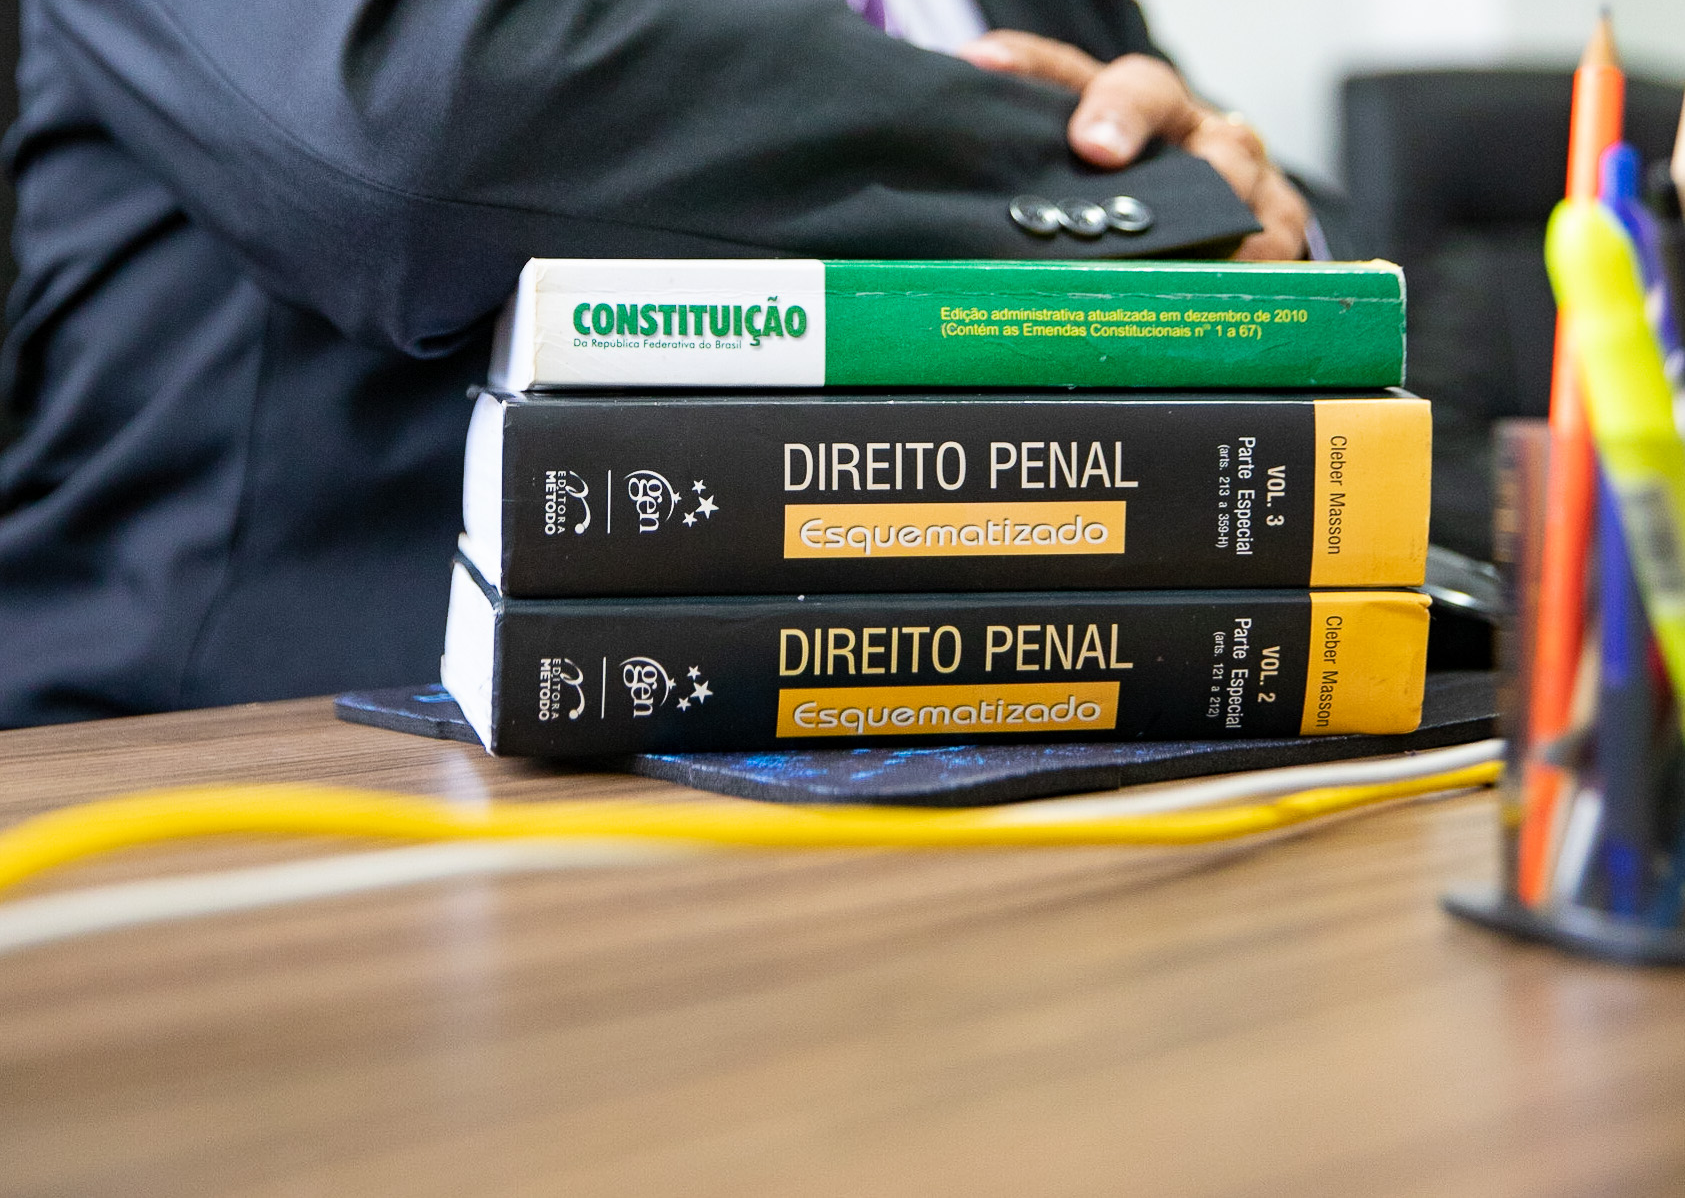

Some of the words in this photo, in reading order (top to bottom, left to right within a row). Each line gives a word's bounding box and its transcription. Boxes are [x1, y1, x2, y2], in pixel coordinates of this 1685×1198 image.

[573, 296, 807, 347] CONSTITUIÇÃO
[940, 307, 988, 323] Edição
[991, 307, 1085, 322] administrativa
[1087, 309, 1157, 322] atualizada
[1159, 312, 1181, 323] em
[1184, 309, 1251, 323] dezembro
[1253, 310, 1271, 323] de
[1274, 309, 1308, 323] 2010
[941, 322, 999, 338] (Contém
[1002, 325, 1020, 337] as
[1022, 323, 1087, 337] Emendas
[1090, 323, 1192, 338] Constitucionais
[1215, 324, 1223, 337] 1
[1226, 327, 1237, 338] a
[1238, 324, 1262, 340] 67)
[573, 338, 588, 348] Da
[643, 339, 695, 350] Federativa
[698, 340, 712, 350] do
[715, 339, 742, 350] Brasil
[784, 440, 967, 491] DIREITO
[990, 440, 1139, 489] PENAL
[1217, 444, 1231, 471] (arts.
[1237, 436, 1256, 479] Parte
[1330, 435, 1348, 486] Cleber
[557, 470, 567, 534] EDITORA
[627, 477, 664, 534] gen
[1219, 476, 1231, 497] 213
[1266, 465, 1286, 508] VOL.
[800, 514, 1109, 556] Esquematizado
[1215, 513, 1230, 549] 359-H)
[1233, 489, 1256, 555] Especial
[1266, 514, 1285, 527] 3
[1327, 492, 1346, 555] Masson
[779, 625, 962, 676] DIREITO
[985, 623, 1134, 672] PENAL
[1212, 631, 1226, 657] (arts.
[1232, 618, 1252, 659] Parte
[1323, 615, 1343, 664] Cleber
[1212, 663, 1224, 679] 121
[1259, 645, 1281, 686] VOL.
[551, 658, 562, 721] EDITORA
[622, 663, 658, 719] gen
[1206, 696, 1221, 718] 212)
[1225, 668, 1249, 728] Especial
[1257, 692, 1276, 703] 2
[1316, 670, 1338, 728] Masson
[793, 696, 1101, 735] Esquematizado
